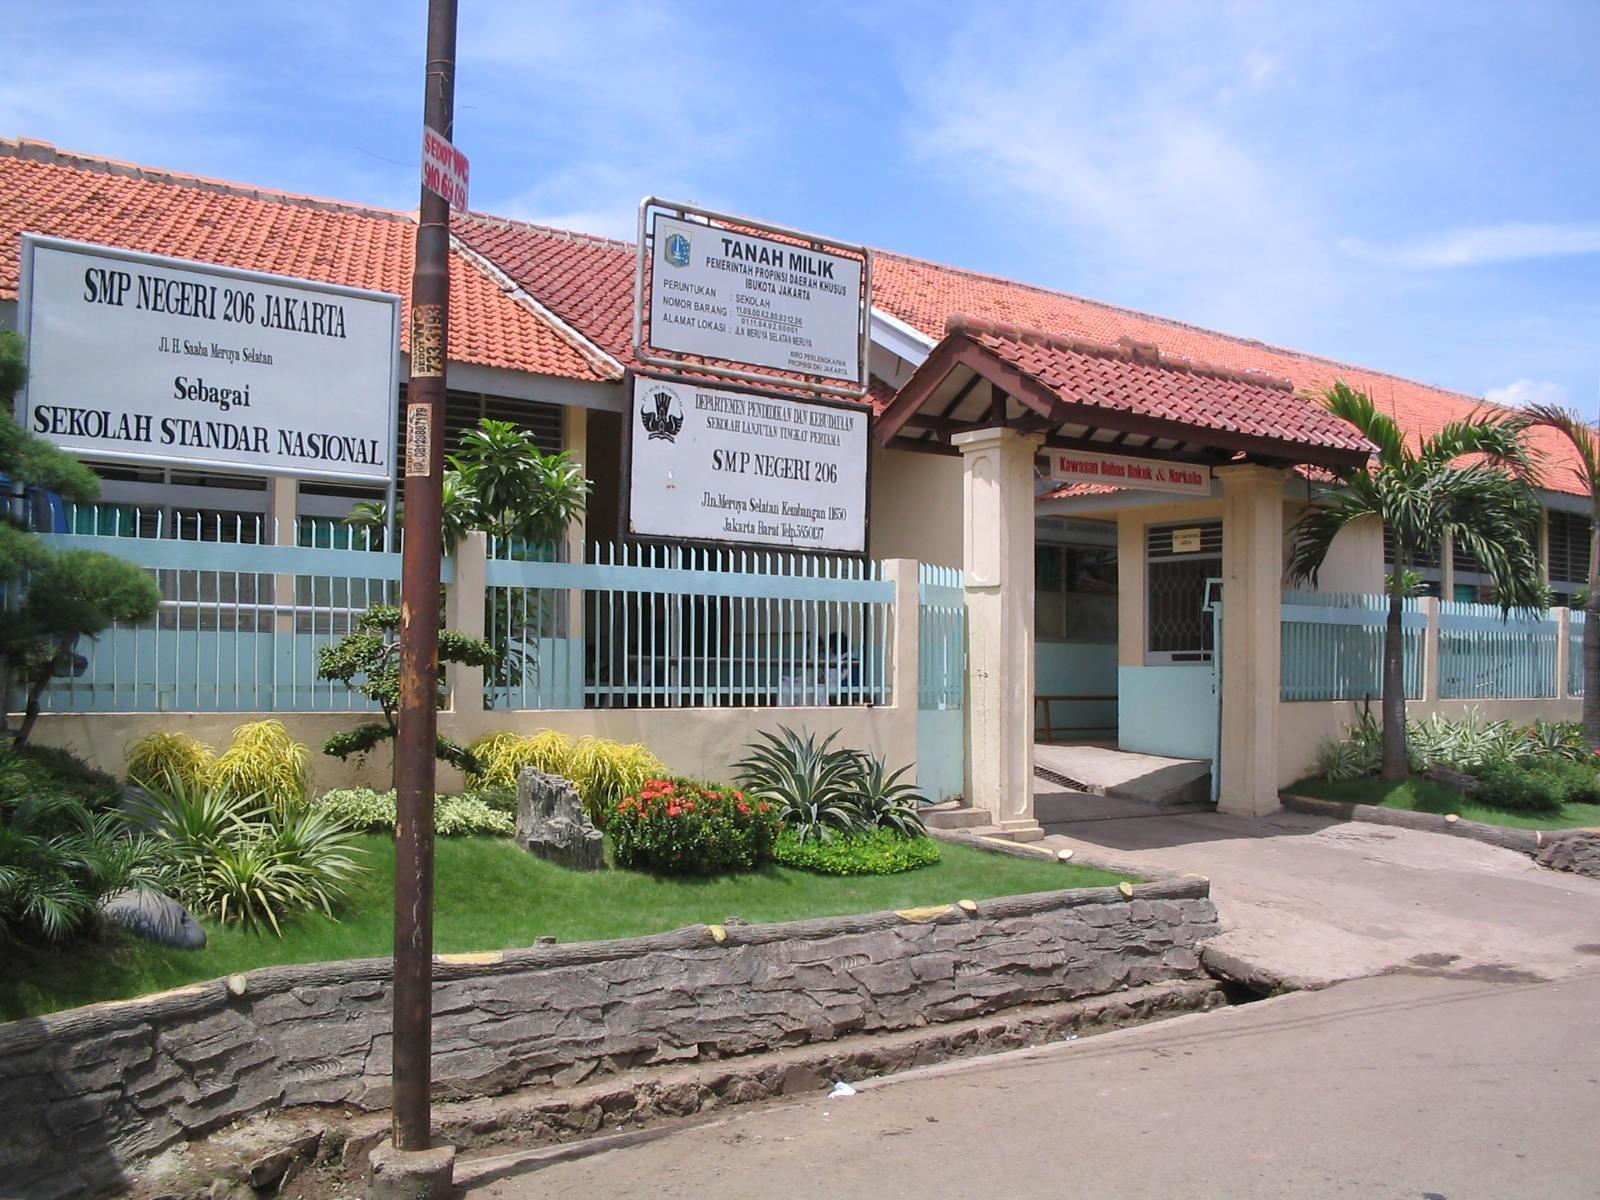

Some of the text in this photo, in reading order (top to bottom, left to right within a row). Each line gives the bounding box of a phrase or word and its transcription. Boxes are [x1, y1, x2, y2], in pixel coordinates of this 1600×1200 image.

[425, 132, 452, 170] SEDOT
[721, 238, 835, 280] TANAH MILIK
[705, 256, 847, 297] PEMERINTAH PROPINSI DAERAH KHUSUS
[745, 278, 811, 302] IBUKOTA JAKARTA
[83, 268, 347, 339] SMP NEGERI 206 JAKARTA
[662, 296, 692, 312] NOMOR
[693, 303, 728, 317] BARANG
[663, 278, 716, 298] PERUNTUKAN
[735, 293, 770, 309] SEKOLAH
[662, 312, 696, 328] ALAMAT
[697, 319, 727, 333] LOKASI
[209, 342, 240, 365] Meruya
[242, 347, 274, 366] Selatan
[173, 375, 251, 411] Sebagai
[695, 393, 745, 416] DEPARTEMEN
[748, 400, 793, 421] PENDIDIKAN
[793, 406, 808, 424] DAN
[808, 408, 855, 432] KEBUDAYAAN
[33, 404, 384, 467] SEKOLAH STANDAR NASIONAL
[706, 416, 841, 447] SEKOLAH LANJUTAN TINGKAT PERTAMA
[712, 448, 838, 484] SMP NEGERI 206
[1155, 467, 1167, 482] &
[749, 497, 779, 515] Selatan
[781, 500, 826, 522] Kembangan
[722, 517, 755, 534] Jakarta
[757, 519, 779, 536] Barat
